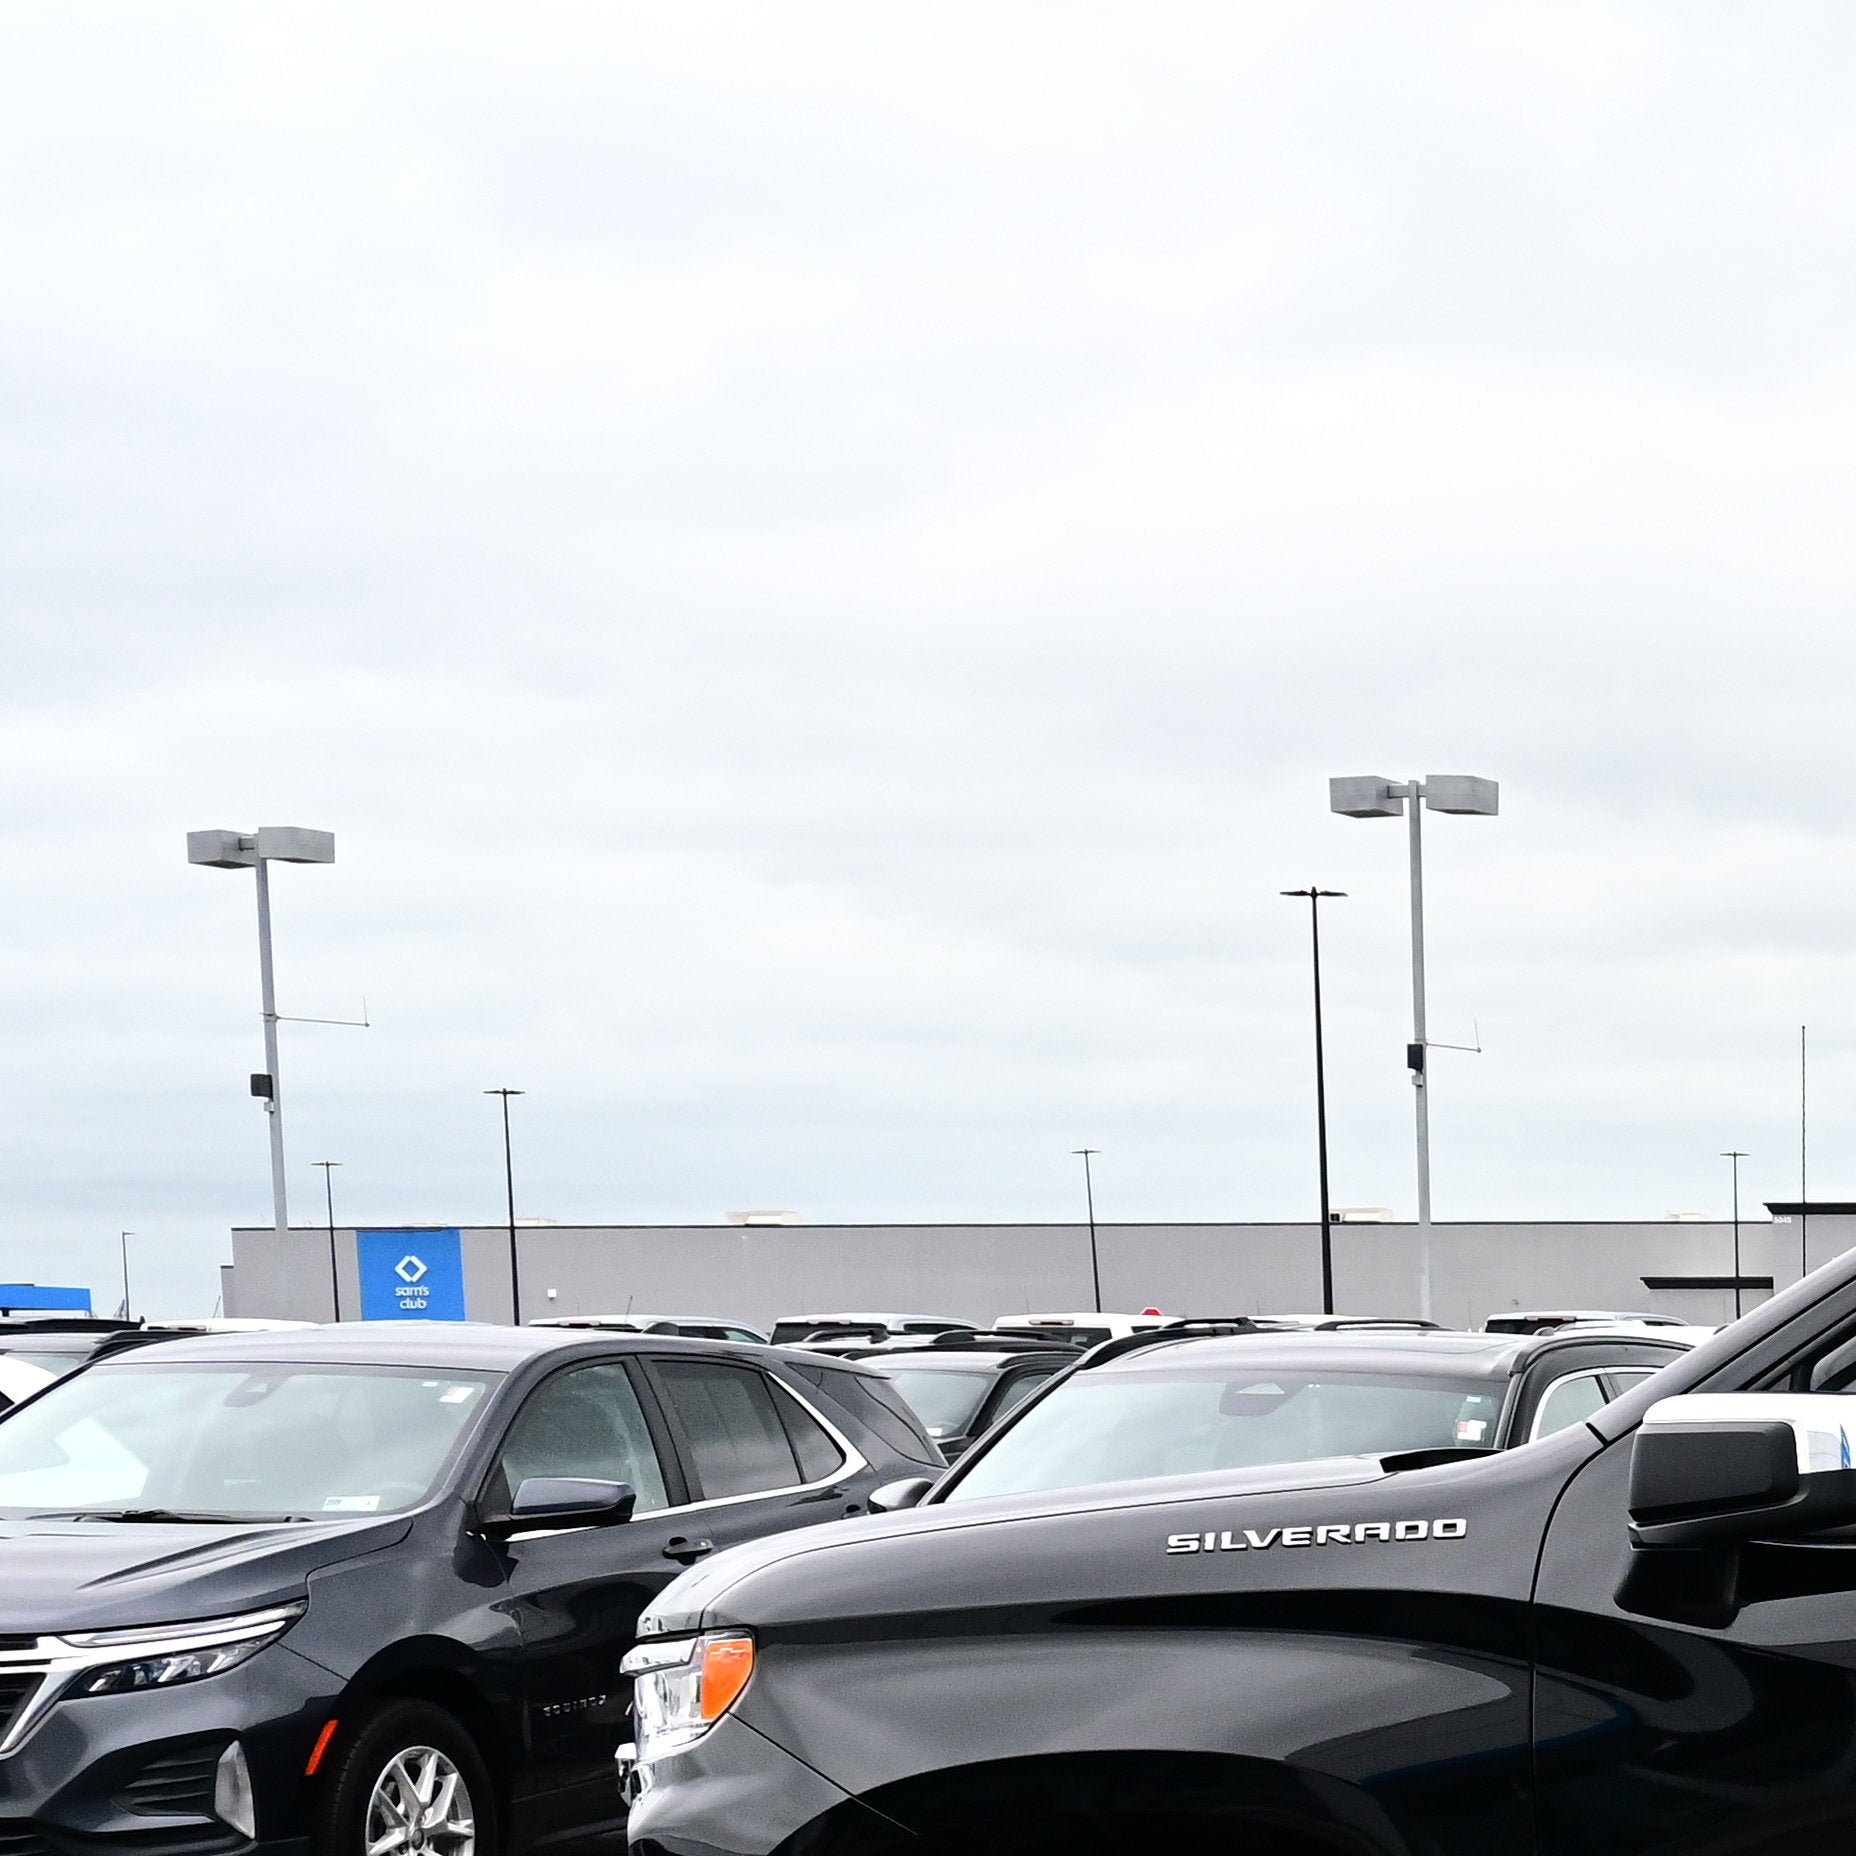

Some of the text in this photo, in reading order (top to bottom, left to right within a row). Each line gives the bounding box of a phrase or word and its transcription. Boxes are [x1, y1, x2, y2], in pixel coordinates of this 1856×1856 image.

[394, 1285, 430, 1296] sam's
[400, 1297, 427, 1309] club
[1166, 1518, 1467, 1554] SILVERADO
